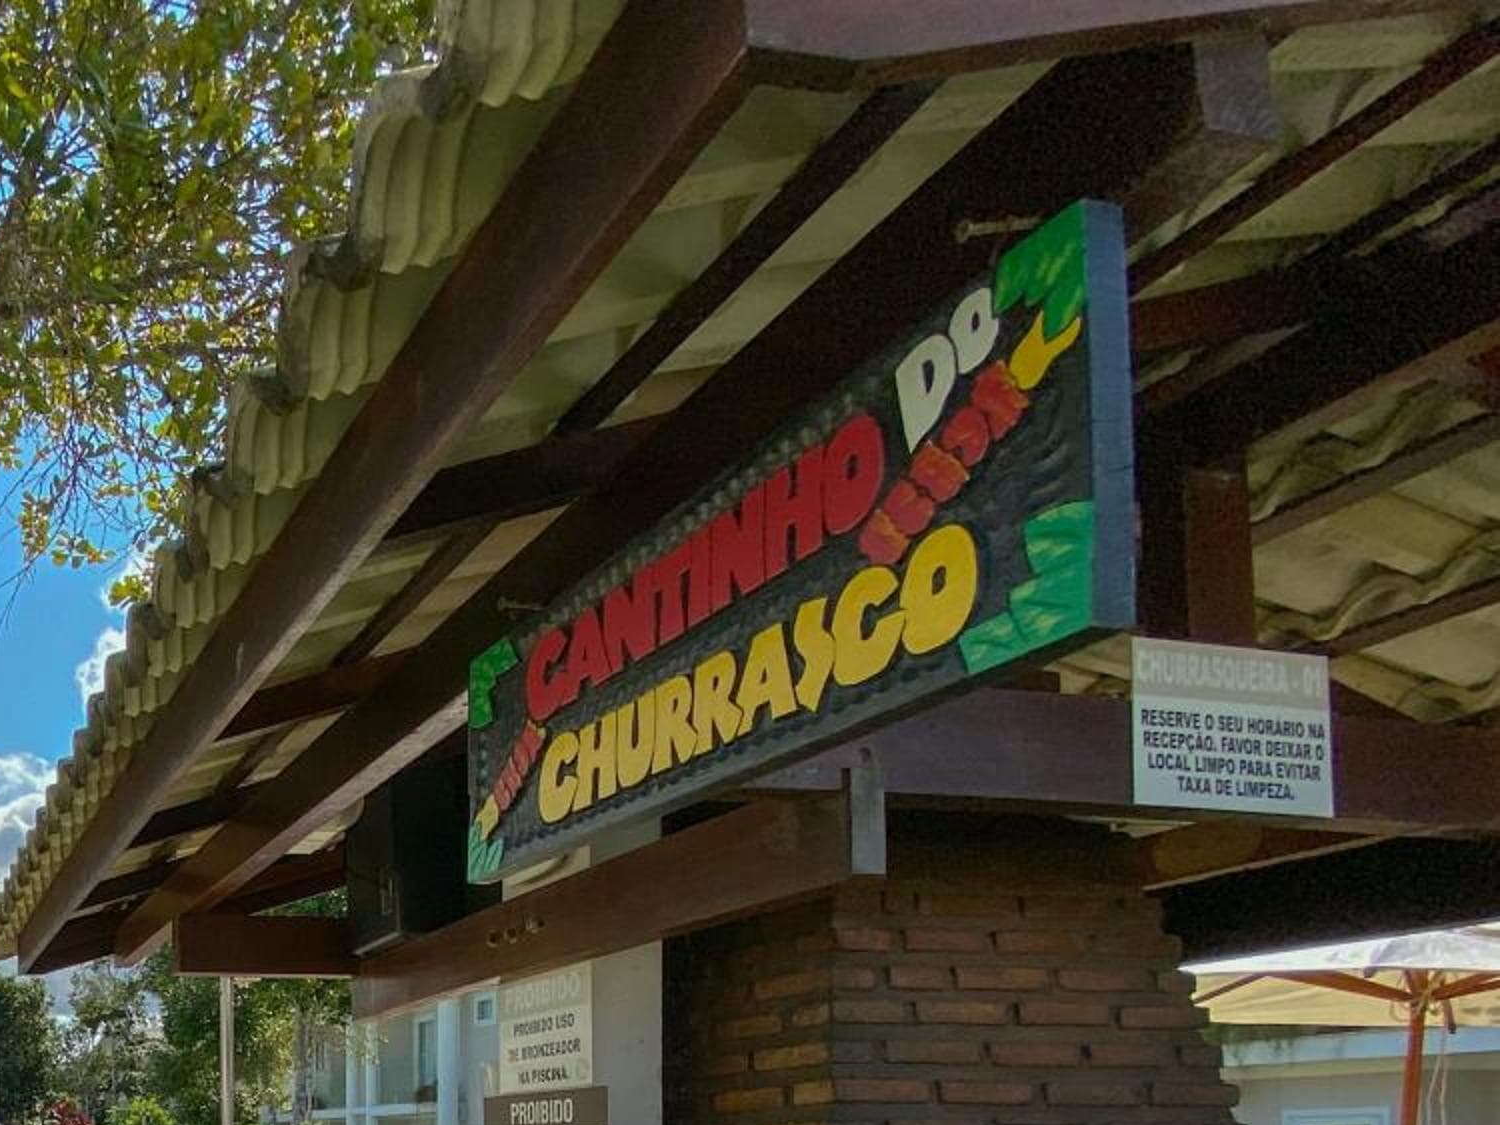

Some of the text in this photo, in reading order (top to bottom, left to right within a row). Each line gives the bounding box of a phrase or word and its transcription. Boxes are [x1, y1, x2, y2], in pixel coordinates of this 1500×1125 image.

[526, 287, 1000, 722] CANTINHO DO
[538, 523, 979, 824] CHURRASCO
[1138, 650, 1289, 694] CHURRASQUEIRA
[1141, 708, 1325, 740] RESERVE O SEU HORÁRIO NA
[1220, 736, 1262, 757] FAVOR
[1265, 740, 1312, 761] DEIXAR
[1315, 744, 1325, 761] O
[1147, 752, 1322, 782] LOCAL LIMPO PARA EVITAR
[1177, 776, 1296, 800] TAXA DE LIMPEZA.
[514, 1012, 575, 1037] PROIBIDO USO
[521, 1038, 581, 1061] BRONZEADOR
[510, 1097, 574, 1125] PROIBIDO
